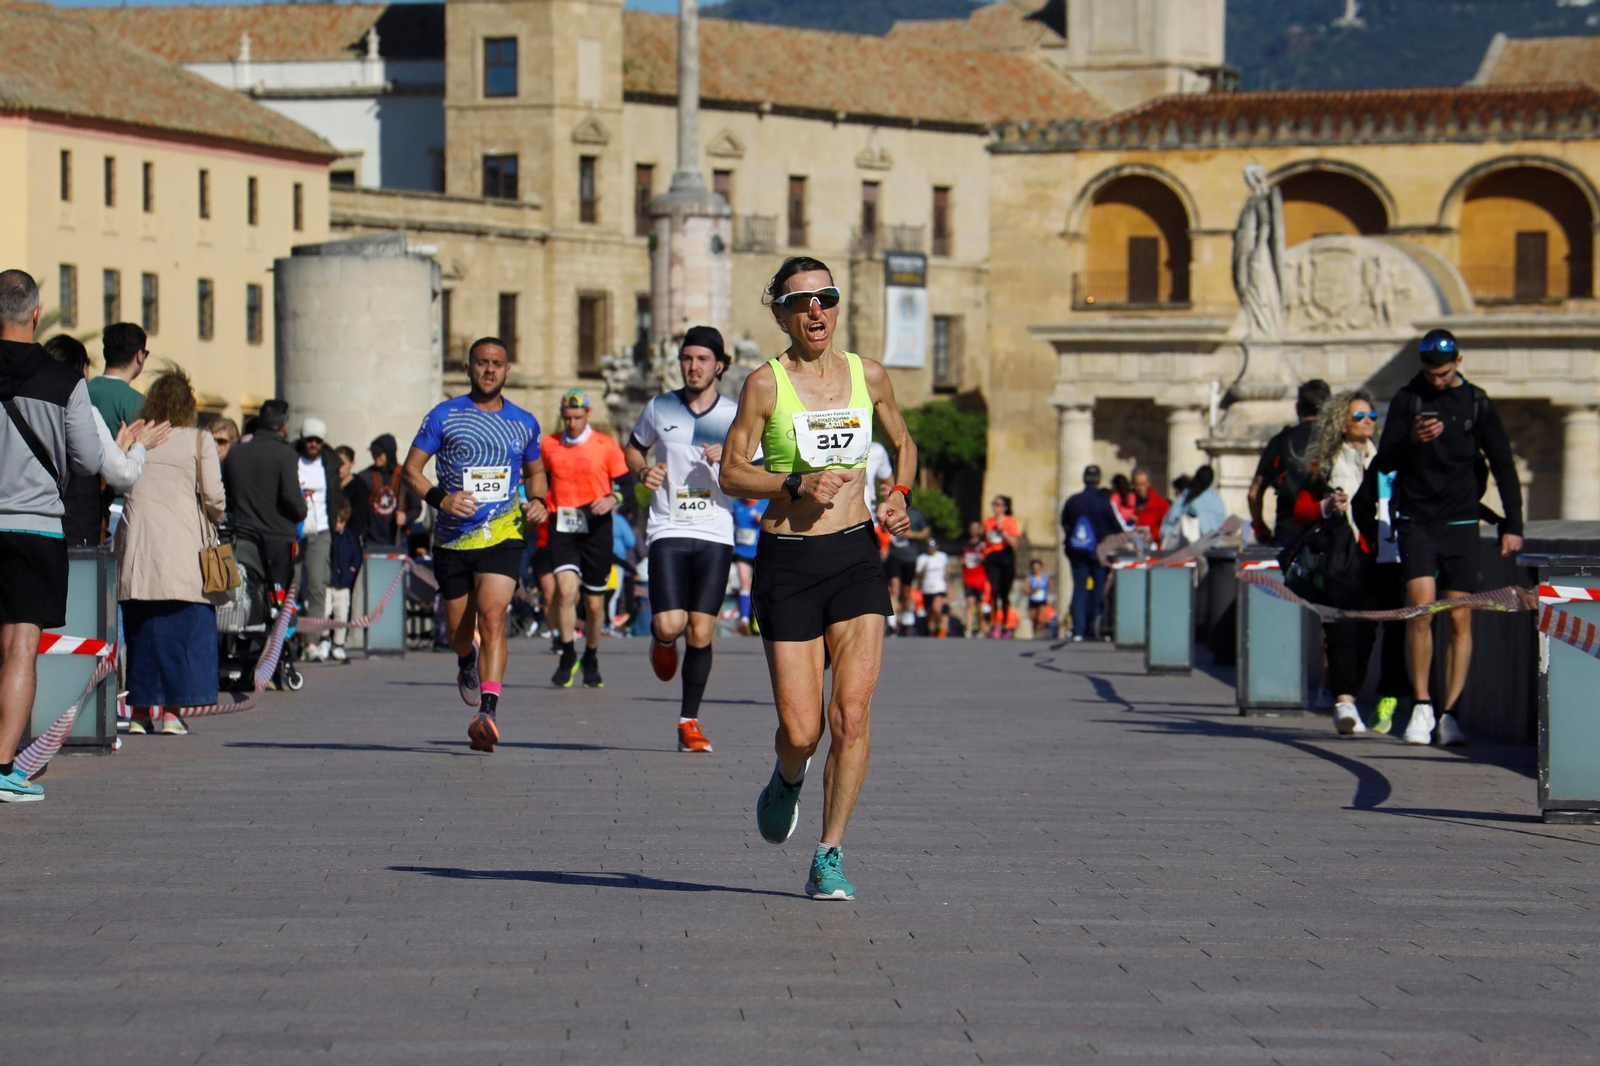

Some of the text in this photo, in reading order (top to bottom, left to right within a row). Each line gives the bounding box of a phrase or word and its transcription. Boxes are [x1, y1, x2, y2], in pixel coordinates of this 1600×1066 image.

[817, 433, 854, 450] 317
[475, 482, 501, 492] 129
[679, 501, 707, 511] 440
